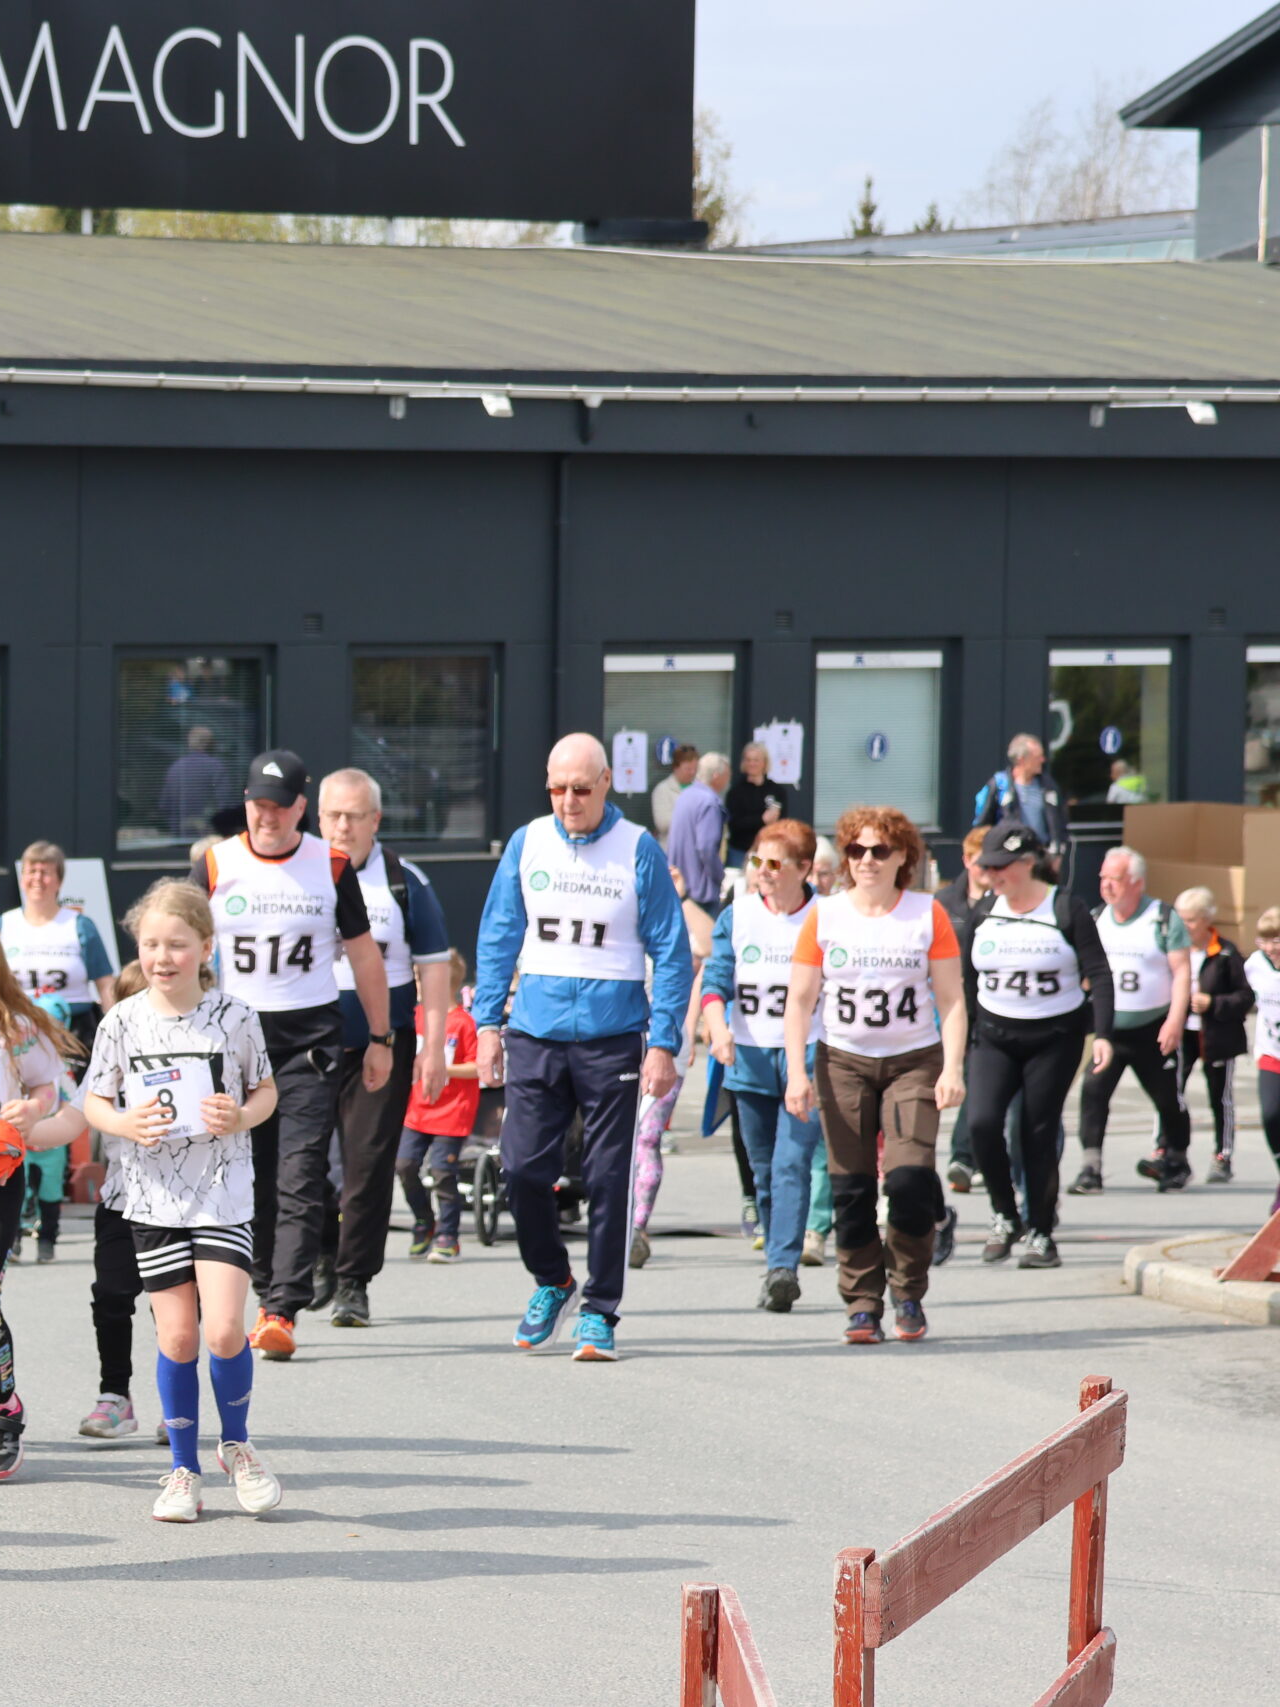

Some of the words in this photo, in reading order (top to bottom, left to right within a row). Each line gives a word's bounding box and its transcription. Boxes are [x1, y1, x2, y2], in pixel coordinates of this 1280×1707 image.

[553, 881, 622, 899] HEDMARK
[252, 903, 323, 916] HEDMARK
[536, 917, 607, 949] 511
[233, 934, 314, 974] 514
[852, 957, 921, 968] HEDMARK
[15, 969, 68, 990] 13
[983, 969, 1061, 997] 545
[1120, 970, 1140, 992] 8
[738, 984, 789, 1017] 53
[837, 987, 918, 1028] 534
[157, 1088, 177, 1121] 8
